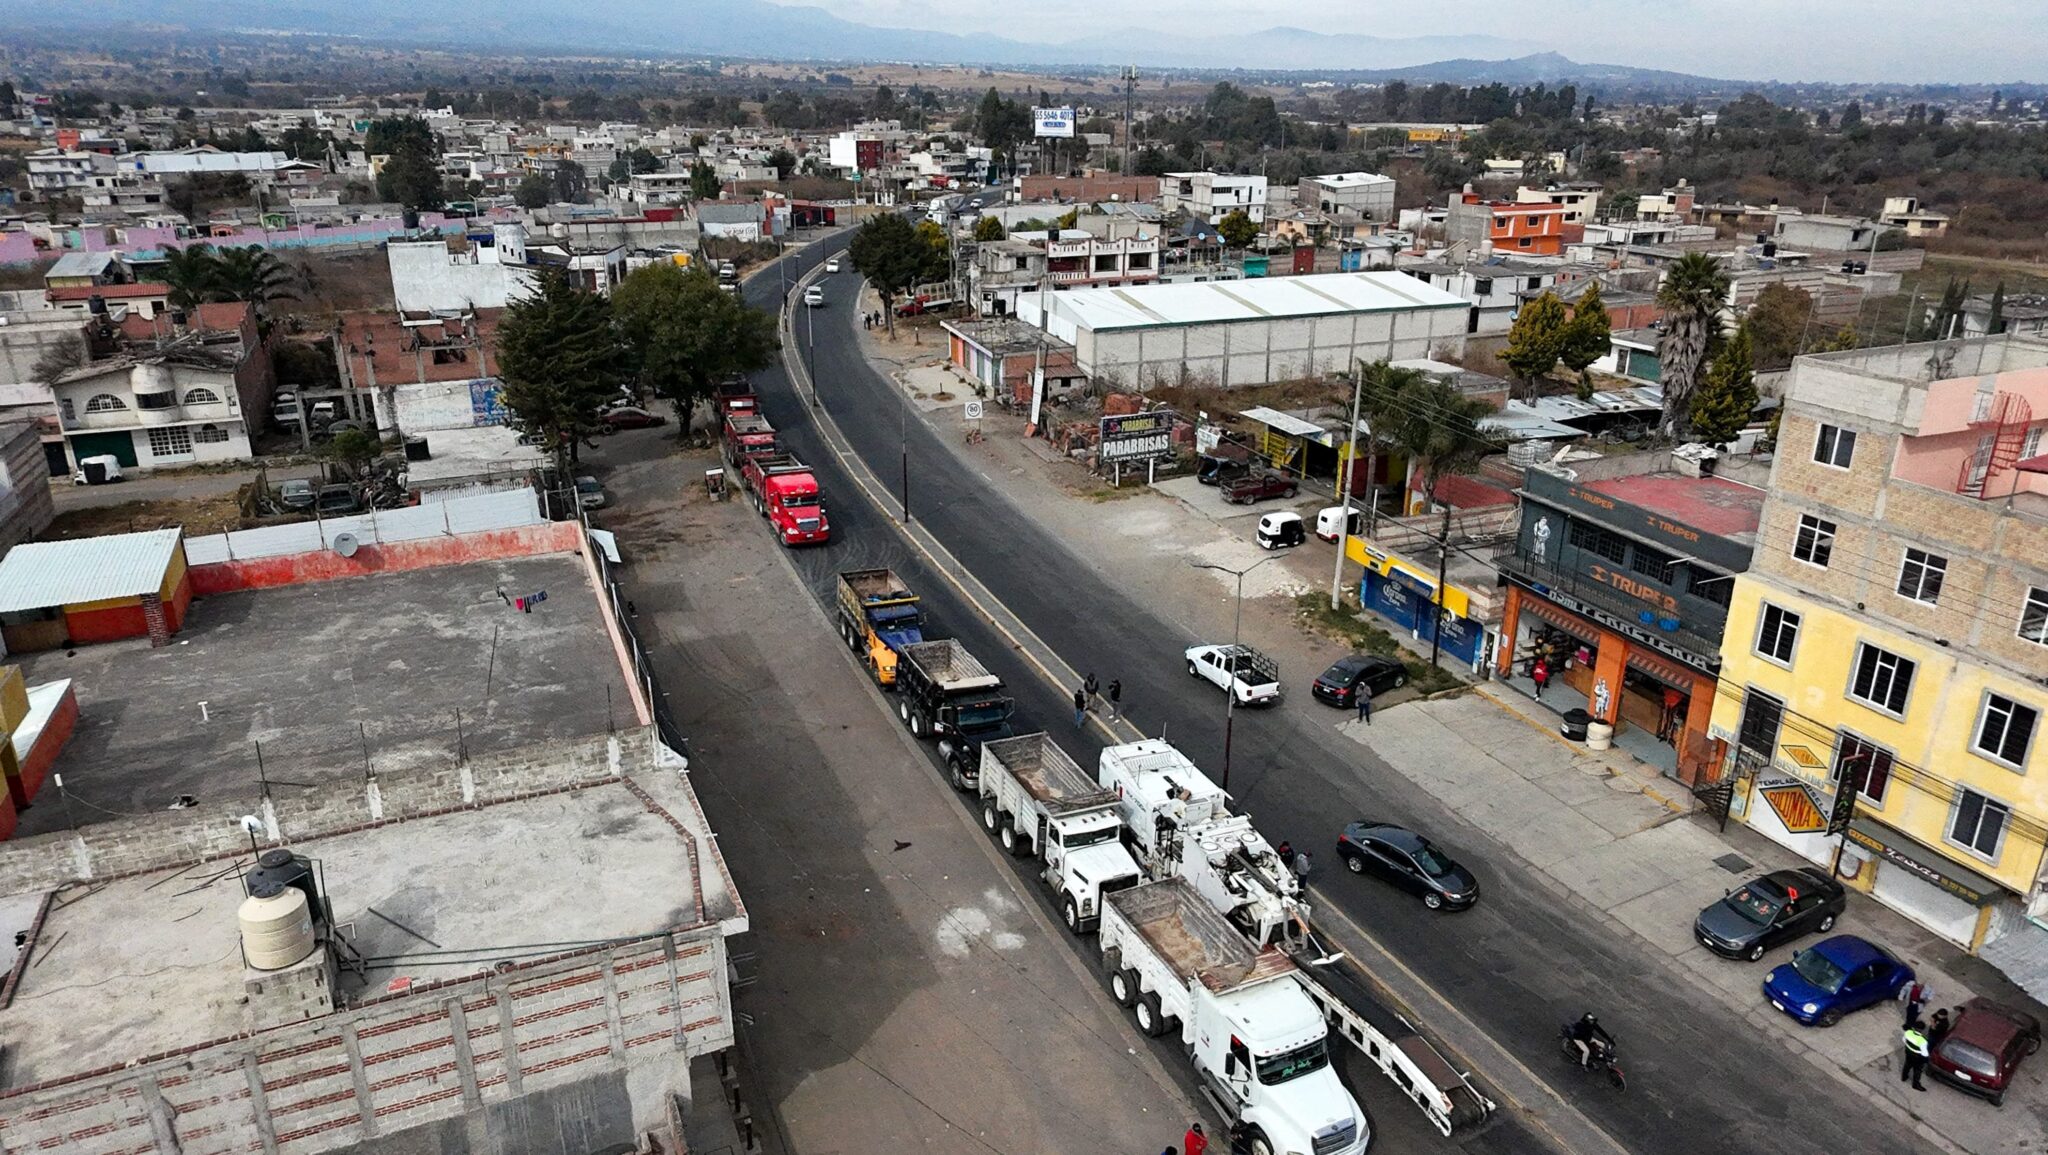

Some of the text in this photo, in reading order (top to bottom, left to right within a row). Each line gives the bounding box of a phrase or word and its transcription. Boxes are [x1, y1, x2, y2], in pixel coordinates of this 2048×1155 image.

[1122, 418, 1155, 432] PARABRISAS
[1103, 434, 1169, 457] PARABRISAS
[1580, 491, 1616, 510] TRUPER
[1659, 520, 1700, 543] TRUPER
[1611, 572, 1678, 610] TRUPER
